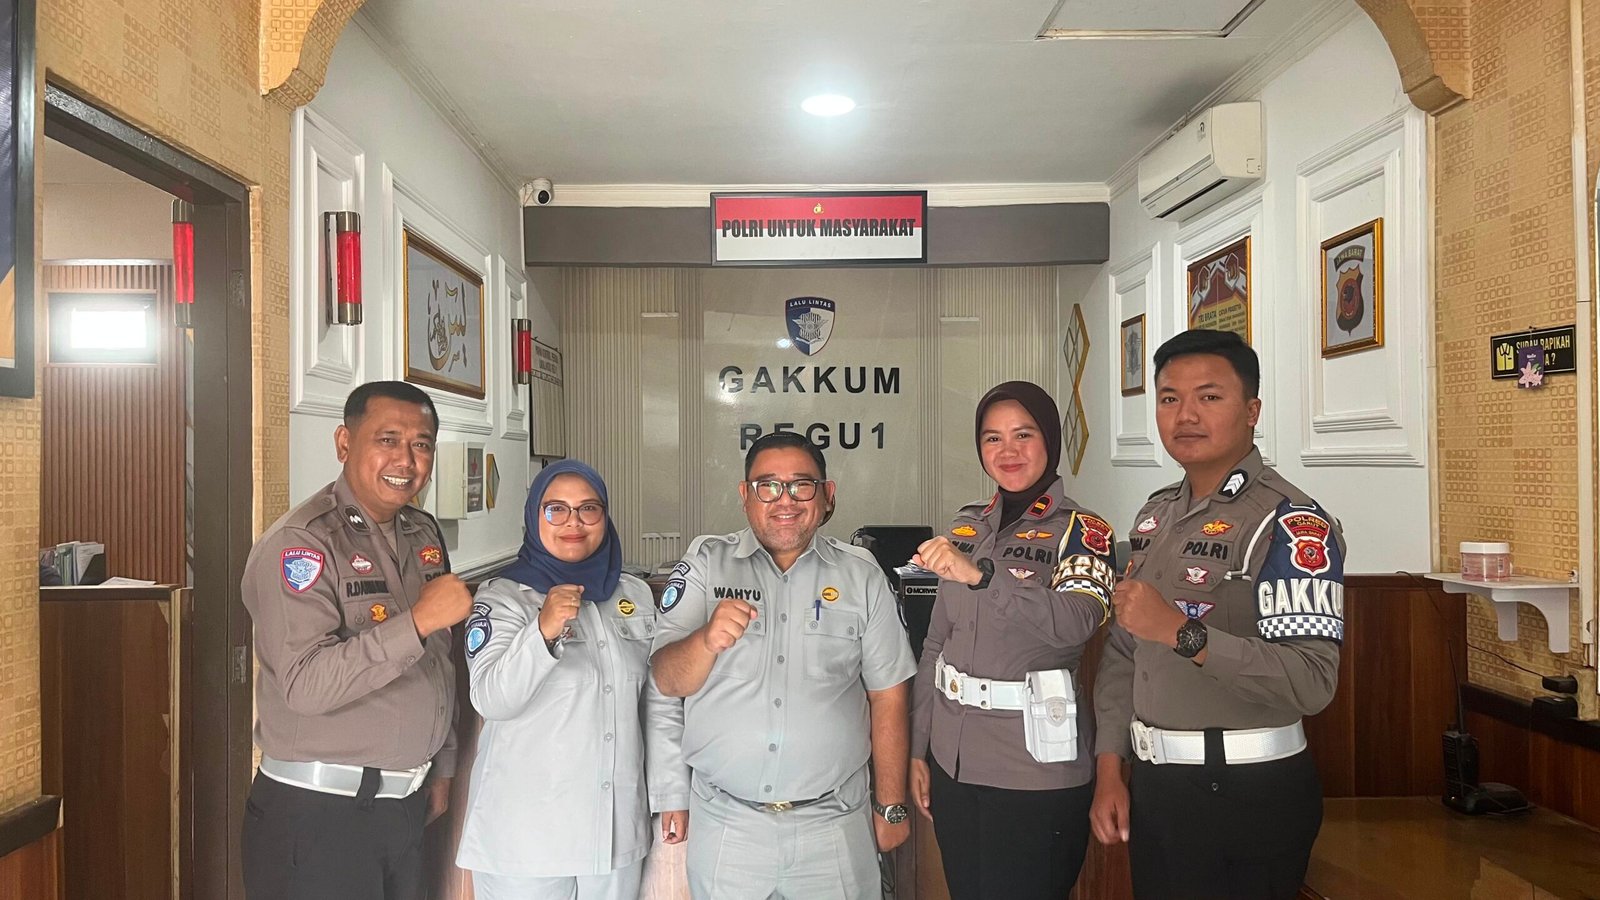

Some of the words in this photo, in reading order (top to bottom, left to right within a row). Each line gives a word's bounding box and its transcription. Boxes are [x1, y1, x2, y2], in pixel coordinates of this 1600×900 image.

[722, 219, 763, 238] POLRI
[768, 219, 817, 238] UNTUK
[820, 218, 916, 237] MASYARAKAT
[790, 299, 807, 307] LALU
[808, 299, 832, 308] LINTAS
[718, 365, 900, 394] GAKKUM
[301, 550, 321, 561] LINTAS
[1002, 546, 1053, 565] POLRI
[1182, 541, 1228, 561] POLRI
[714, 586, 761, 601] WAHYU
